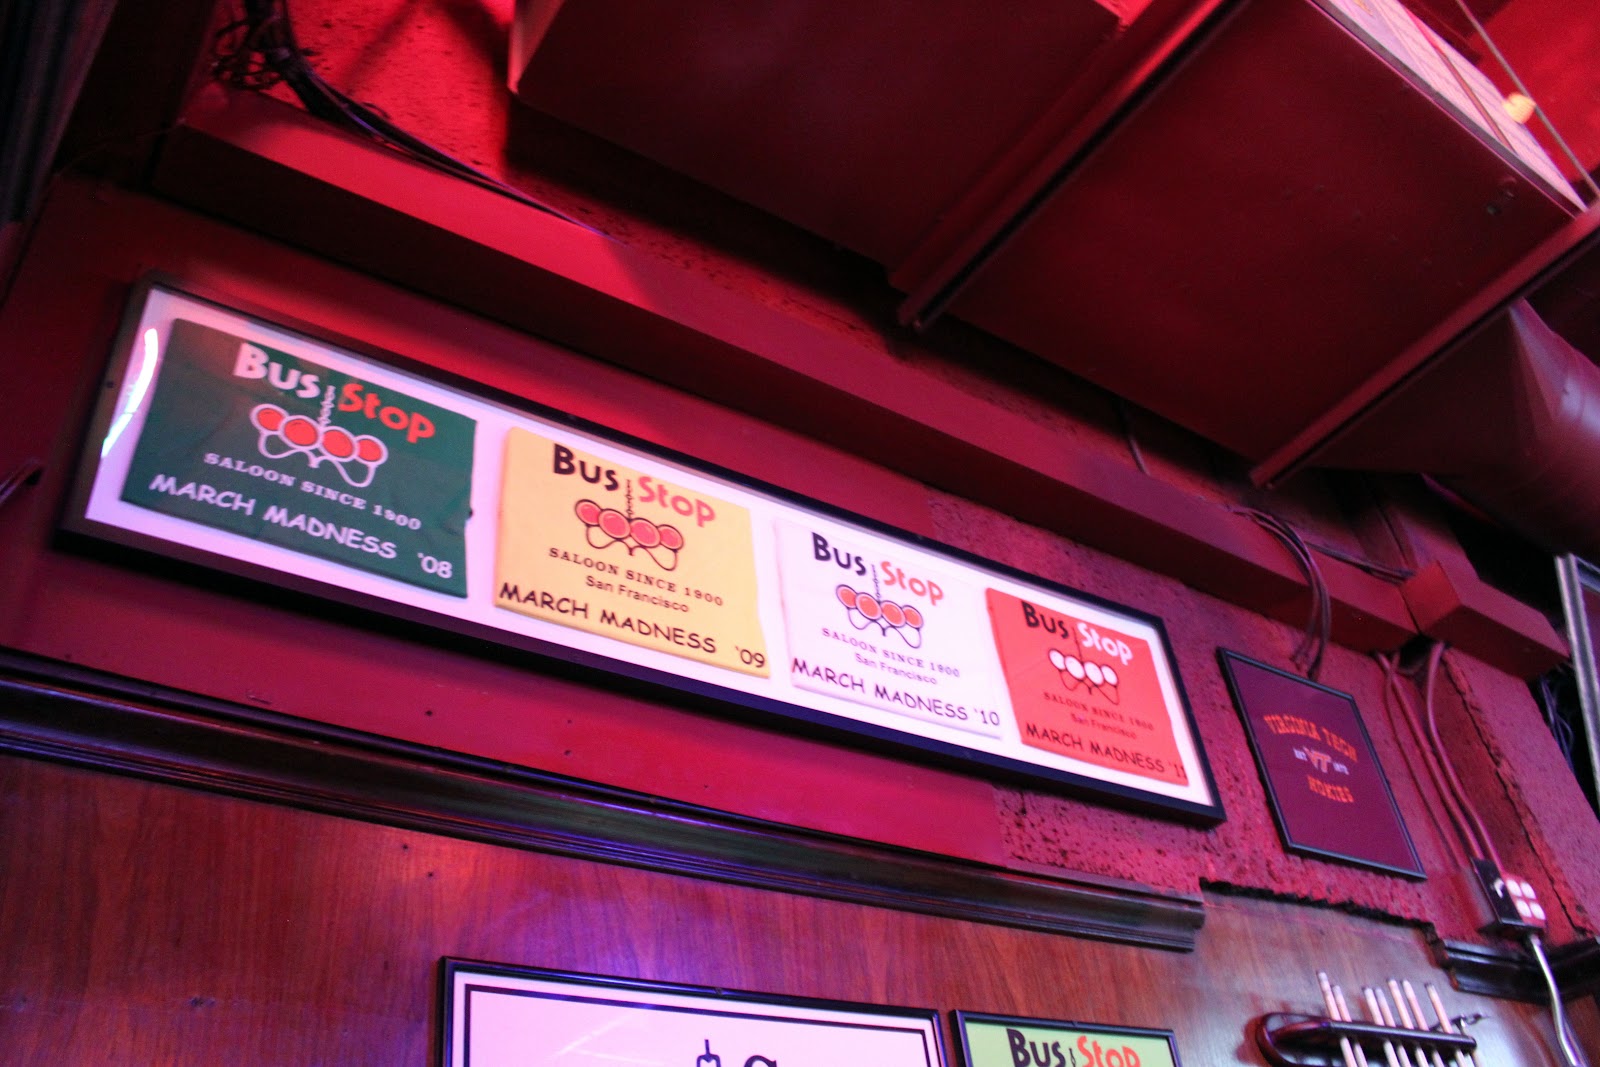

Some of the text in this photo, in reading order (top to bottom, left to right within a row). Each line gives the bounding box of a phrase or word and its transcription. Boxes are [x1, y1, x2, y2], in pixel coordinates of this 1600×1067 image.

[233, 343, 436, 444] Bus Stop
[204, 452, 422, 531] SALOON SINCE 1900
[553, 443, 716, 528] Bus Stop
[149, 474, 453, 579] MARCH MADNESS '08
[549, 547, 723, 607] SALOON SINCE 1900
[586, 575, 689, 613] San Francisco
[812, 532, 944, 606] Bus Stop
[499, 582, 765, 669] MARCH MADNESS '09
[822, 627, 960, 678] SALOON SINCE 1900
[1021, 600, 1133, 666] Bus Stop
[792, 657, 1000, 726] MARCH MADNESS '10
[855, 653, 937, 685] San Francisco
[1043, 692, 1088, 711] SALOON
[1091, 706, 1124, 723] SINCE
[1026, 723, 1084, 750] MARCH
[1090, 741, 1165, 773] MADNESS
[1006, 1028, 1142, 1067] Bus Stop
